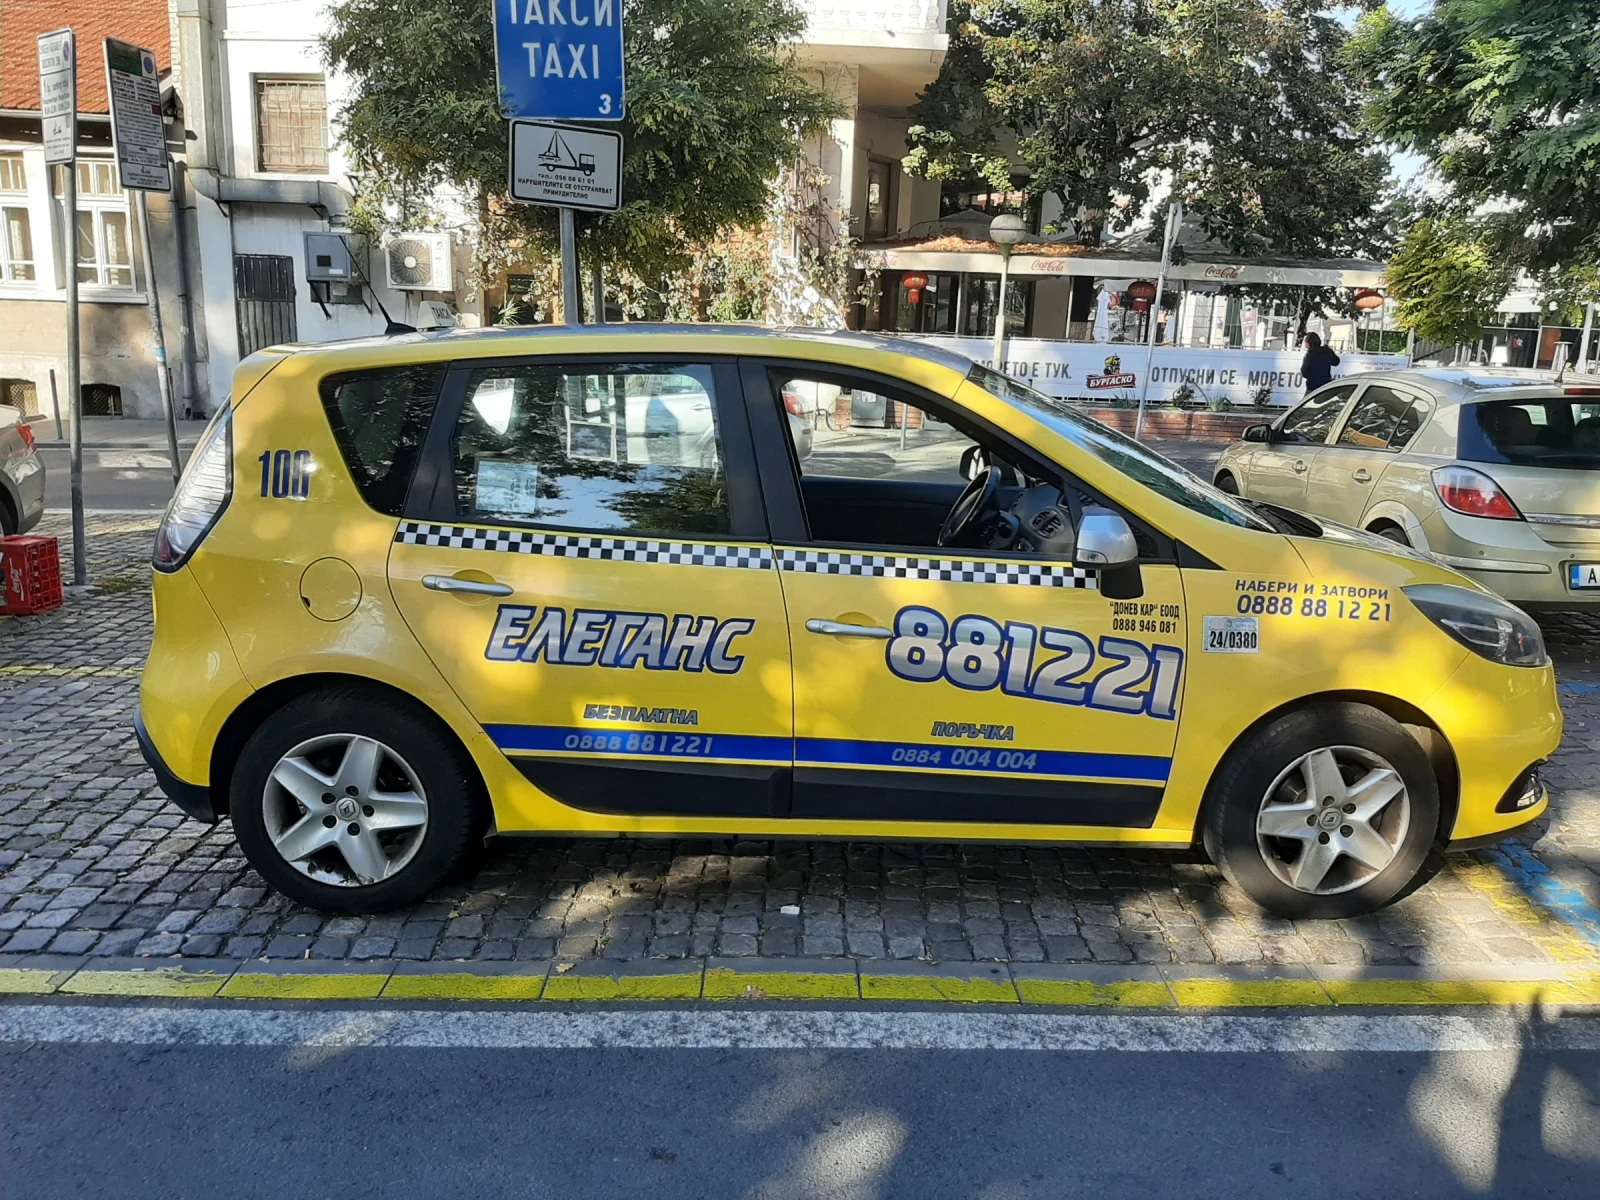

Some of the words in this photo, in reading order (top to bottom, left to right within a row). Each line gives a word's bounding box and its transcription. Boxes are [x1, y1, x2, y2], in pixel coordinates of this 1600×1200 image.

[509, 0, 613, 27] ТАКСИ
[522, 42, 599, 79] TAXI
[598, 93, 612, 115] 3
[517, 177, 564, 189] НАРУШИТЕЛИТЕ
[573, 184, 613, 195] ОТСТРАНЯВАТ
[542, 188, 589, 200] ПРИНУДИТЕЛНО
[1089, 374, 1134, 388] БУРГАСКО
[1151, 366, 1215, 385] ОТПУСНИ
[1219, 370, 1239, 386] СЕ.
[1249, 370, 1302, 389] МОРЕТО
[1588, 567, 1598, 584] A
[1235, 579, 1298, 594] НАБЕРИ
[1304, 583, 1315, 595] И
[1320, 585, 1389, 600] ЗАТВОРИ
[1160, 604, 1180, 621] ЕООД
[1236, 594, 1293, 615] 0888
[1300, 598, 1327, 617] 88
[1338, 600, 1361, 620] 12
[1368, 602, 1391, 622] 21
[1112, 618, 1137, 632] 0888
[1138, 619, 1157, 632] 946
[1159, 620, 1177, 634] 081
[485, 604, 755, 675] ЕЛЕГАНС
[1210, 630, 1257, 649] 24/0380
[885, 605, 1184, 720] 881221
[583, 704, 698, 725] БЕЗПЛАТНА
[931, 721, 1015, 741] ПОРЪЧКА
[891, 748, 942, 764] 0884
[950, 748, 992, 767] 004
[996, 751, 1037, 770] 004
